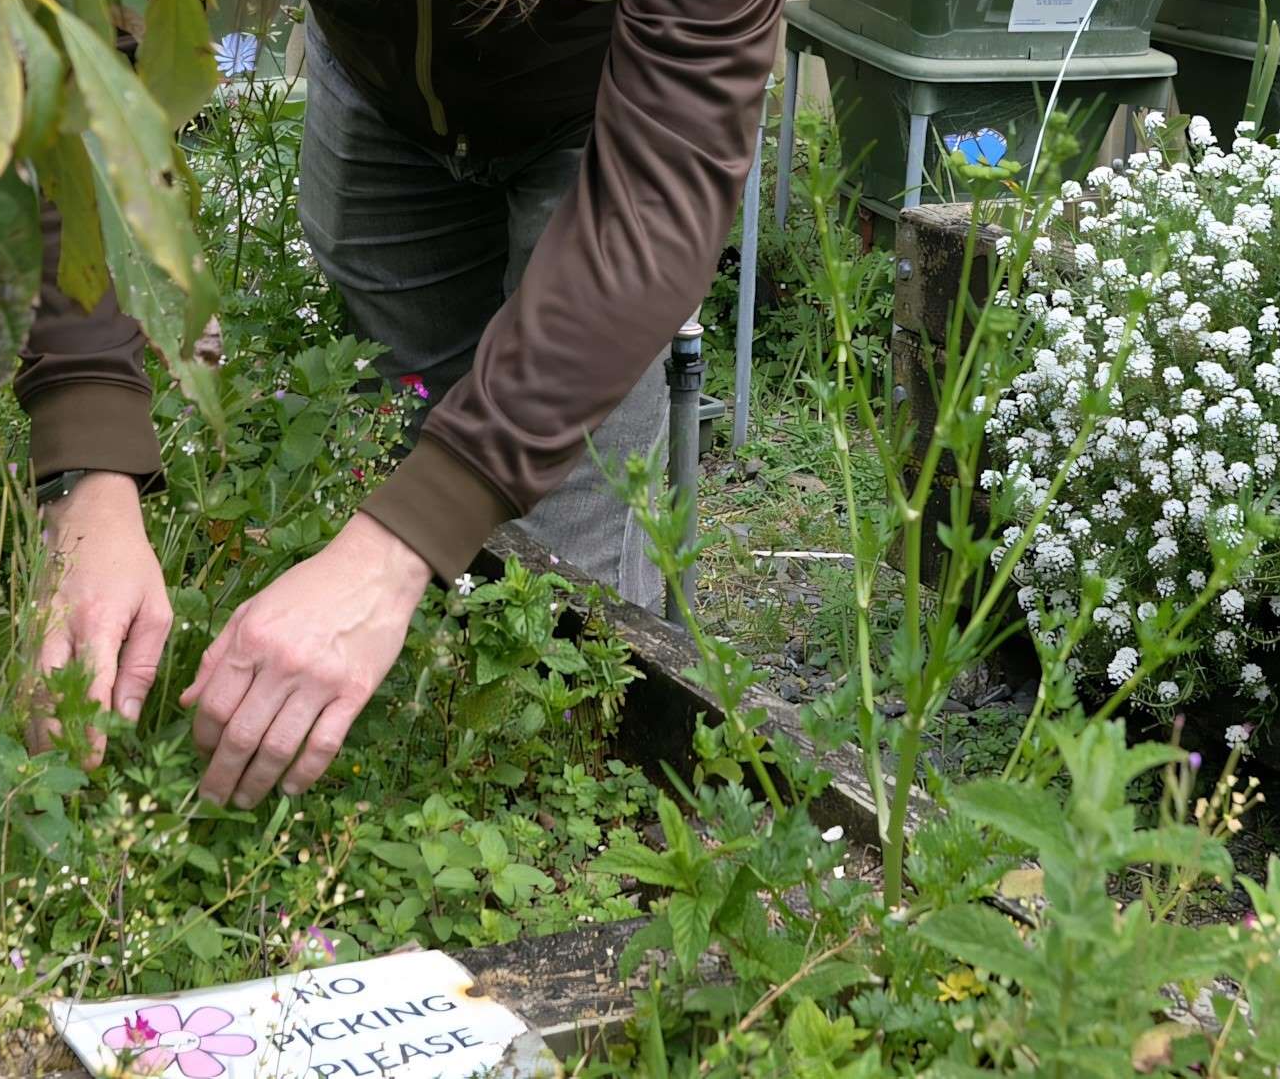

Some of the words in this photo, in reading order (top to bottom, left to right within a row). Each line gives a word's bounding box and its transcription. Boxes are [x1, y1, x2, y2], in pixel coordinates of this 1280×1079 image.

[292, 977, 365, 1004] NO
[272, 995, 457, 1052] PICKING
[310, 1027, 484, 1079] PLEASE
